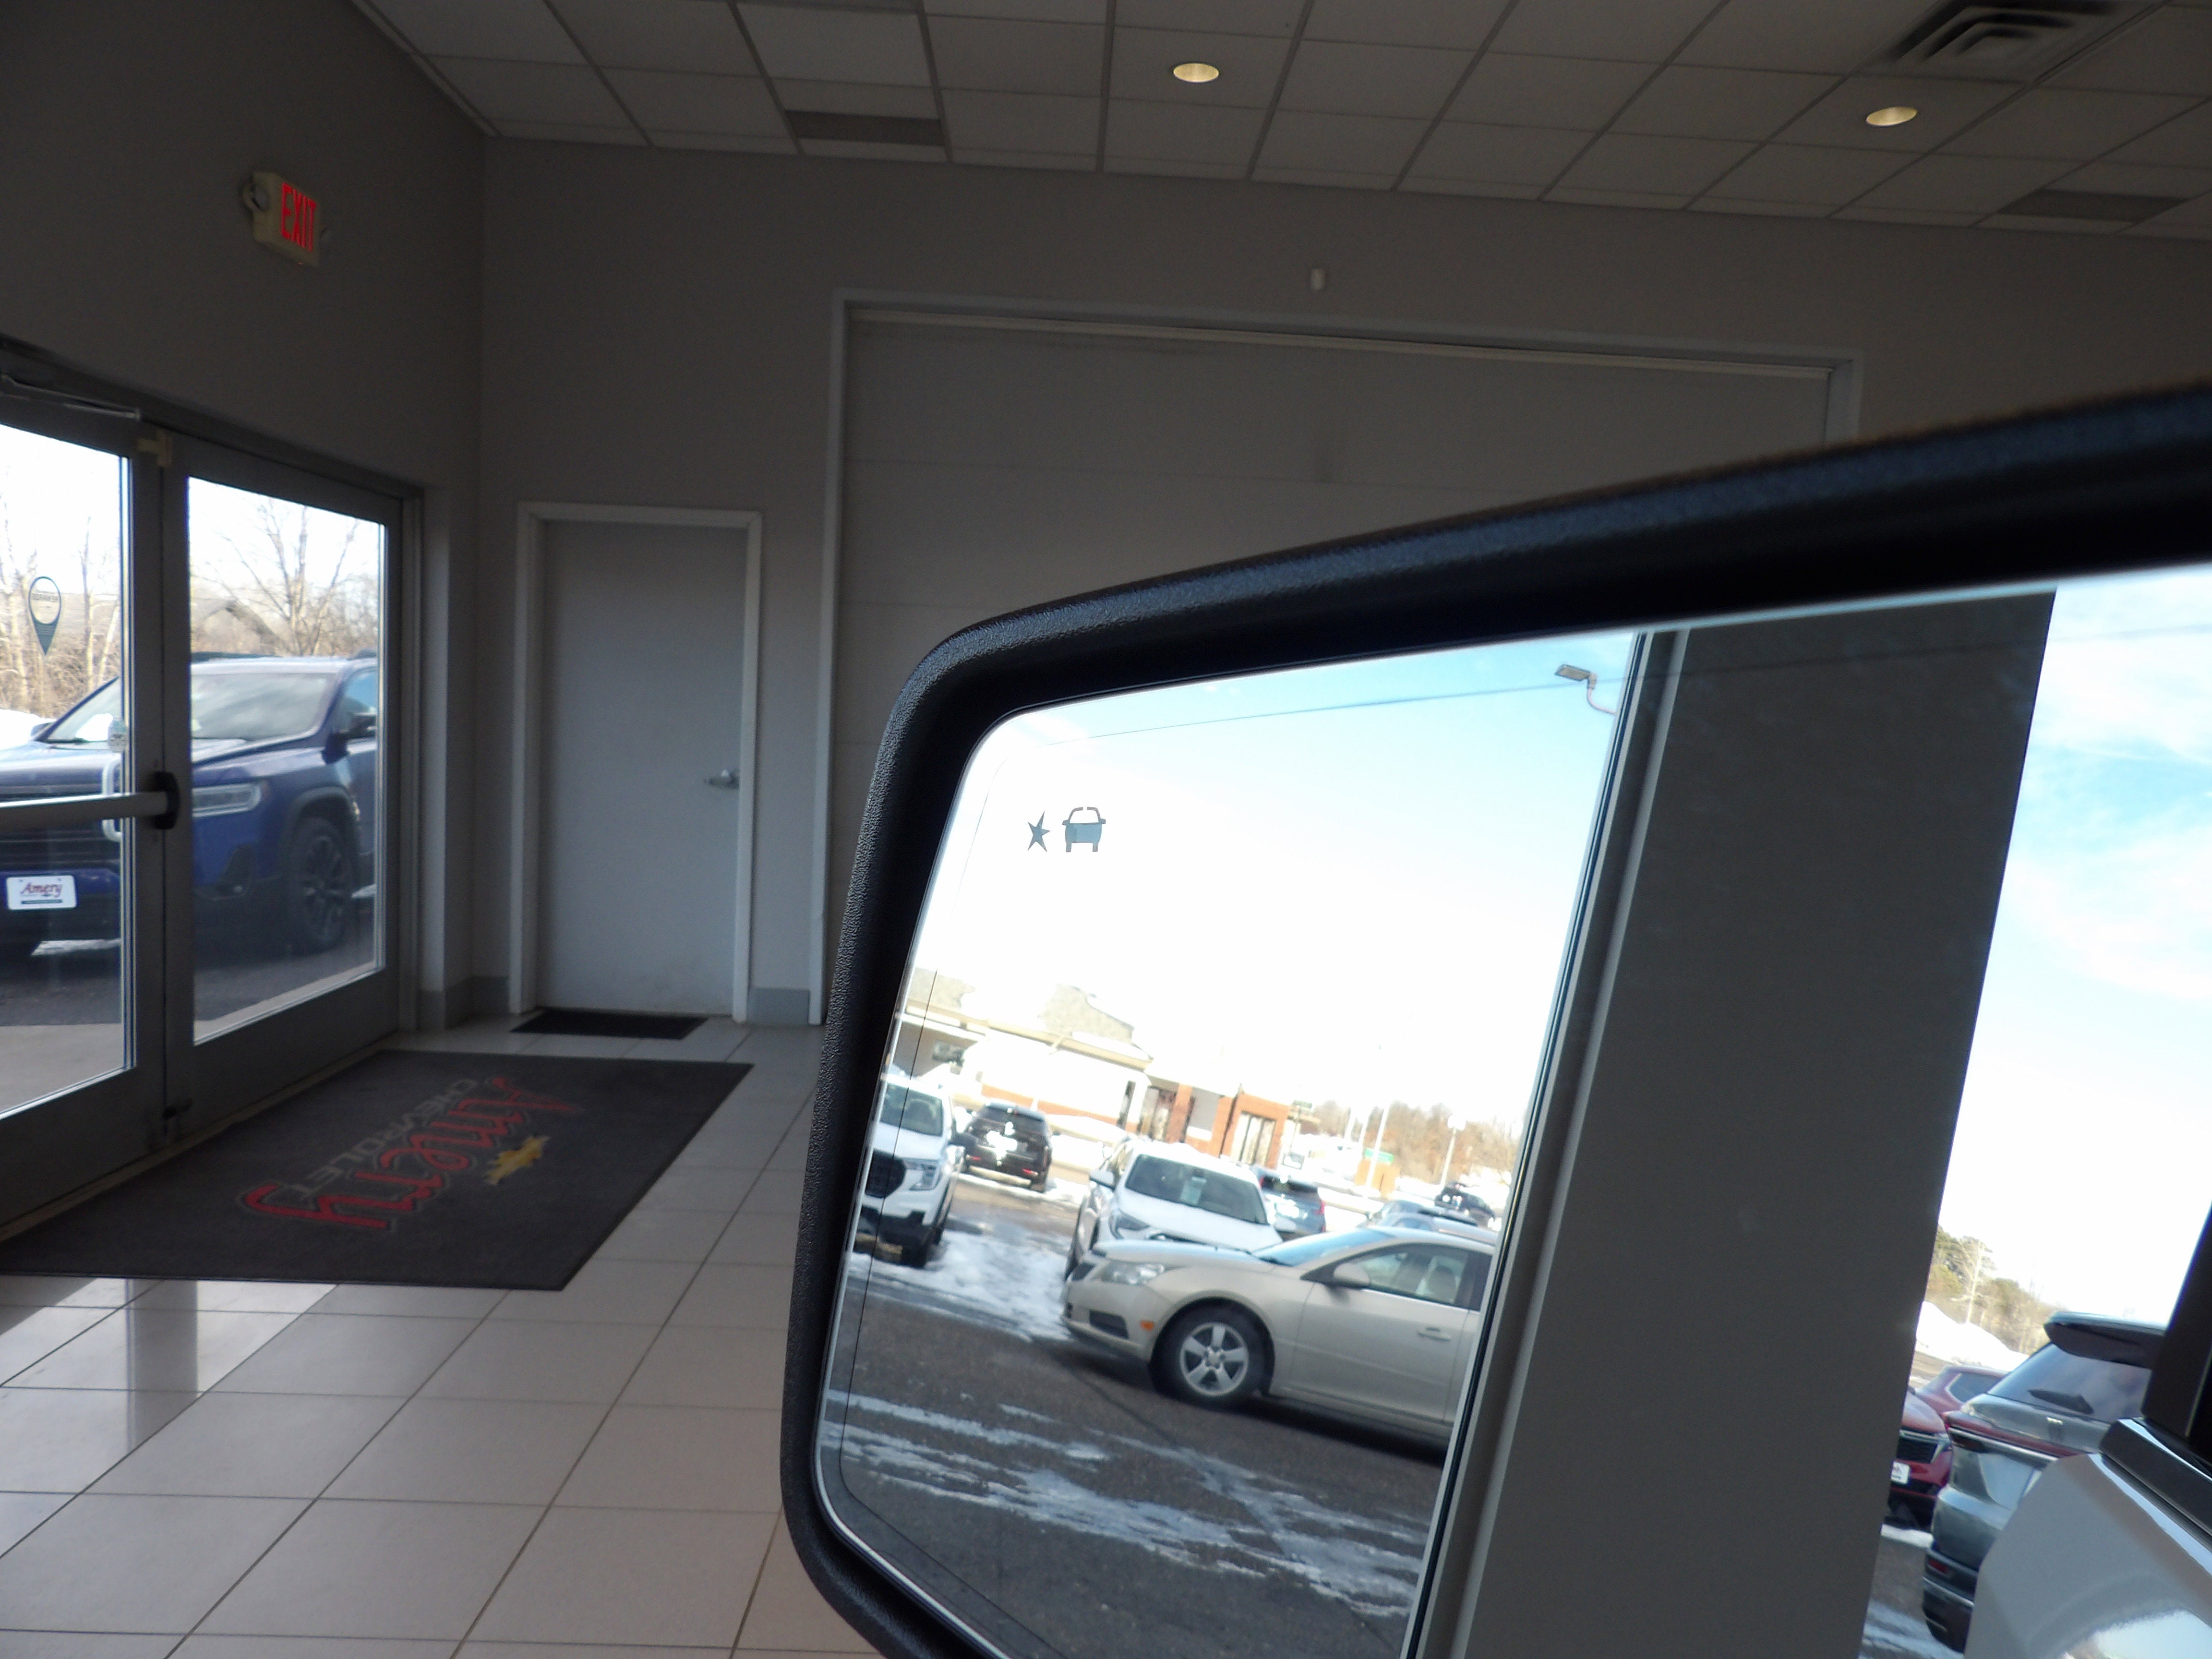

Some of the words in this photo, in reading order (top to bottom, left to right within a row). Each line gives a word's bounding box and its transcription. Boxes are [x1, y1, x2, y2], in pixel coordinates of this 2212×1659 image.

[281, 182, 316, 252] EXIT
[20, 882, 62, 898] Amery
[243, 1076, 576, 1229] Amery
